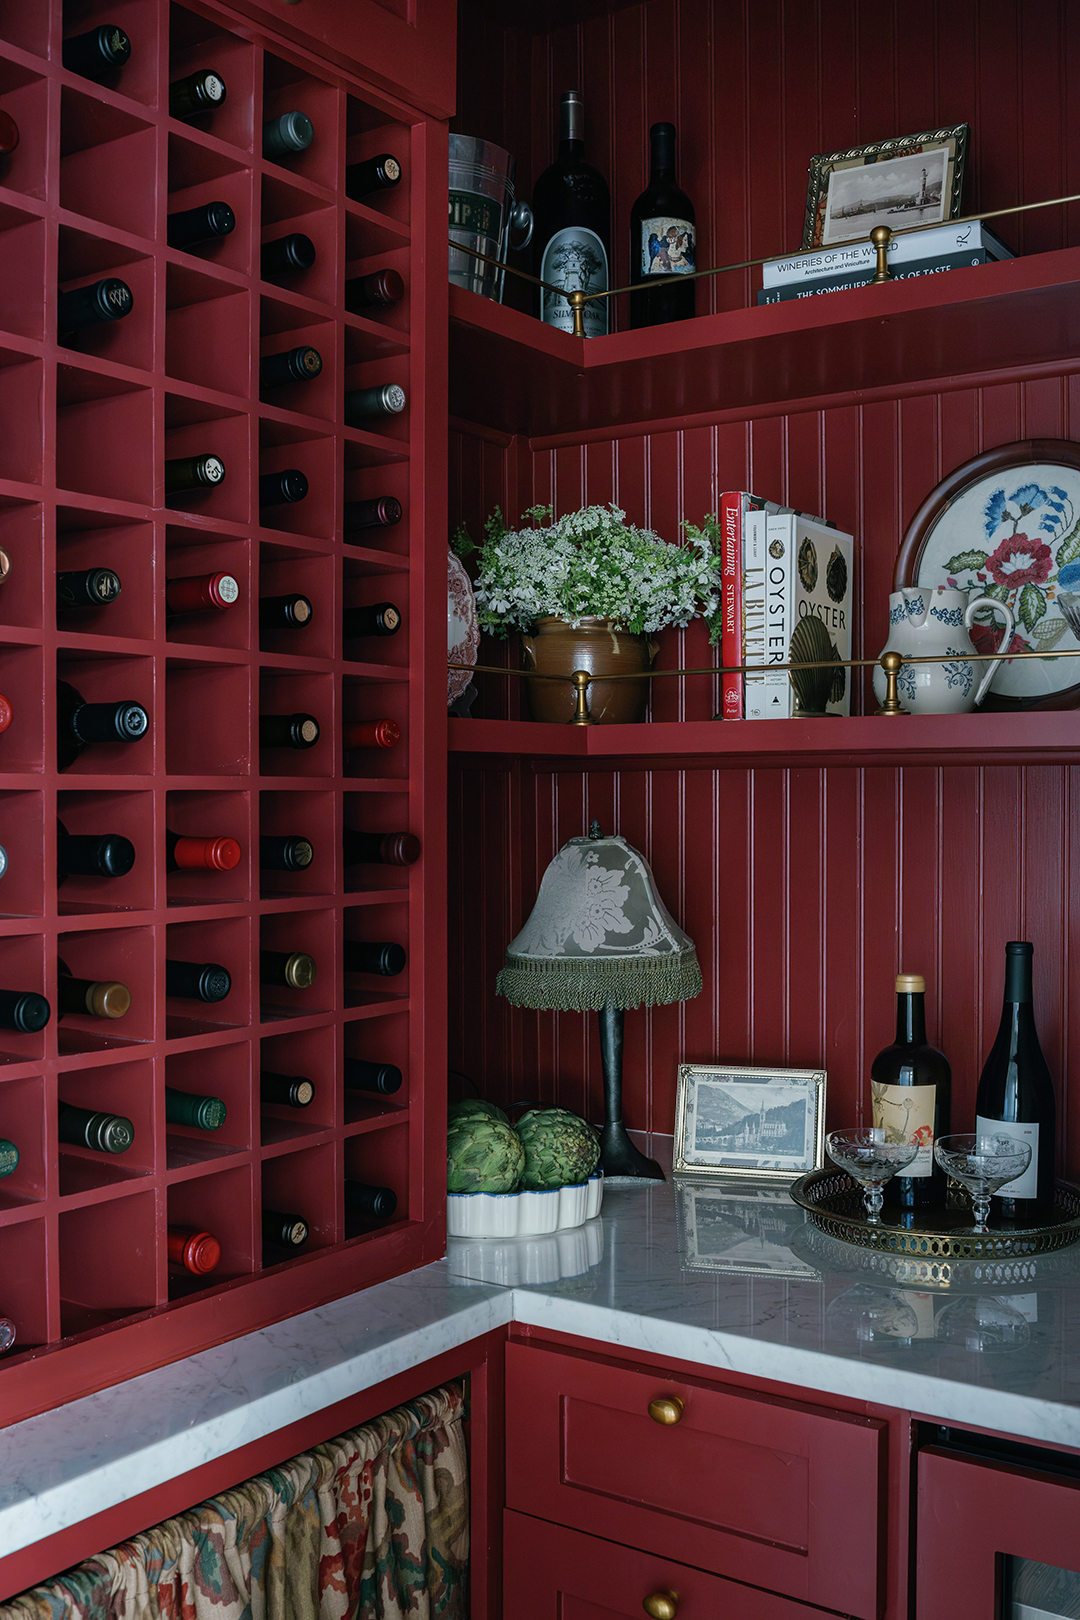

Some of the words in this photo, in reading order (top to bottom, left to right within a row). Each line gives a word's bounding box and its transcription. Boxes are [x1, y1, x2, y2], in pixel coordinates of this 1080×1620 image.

[777, 257, 822, 273] WINERIES
[824, 254, 838, 264] OF
[841, 249, 859, 261] THE
[804, 265, 833, 275] Architecture
[834, 262, 843, 270] and
[844, 259, 870, 268] Viniculture
[724, 507, 739, 576] Entertaining
[746, 567, 764, 590] LA
[727, 584, 735, 634] STEWART
[769, 566, 785, 665] OYSTER
[798, 599, 846, 630] OYSTER
